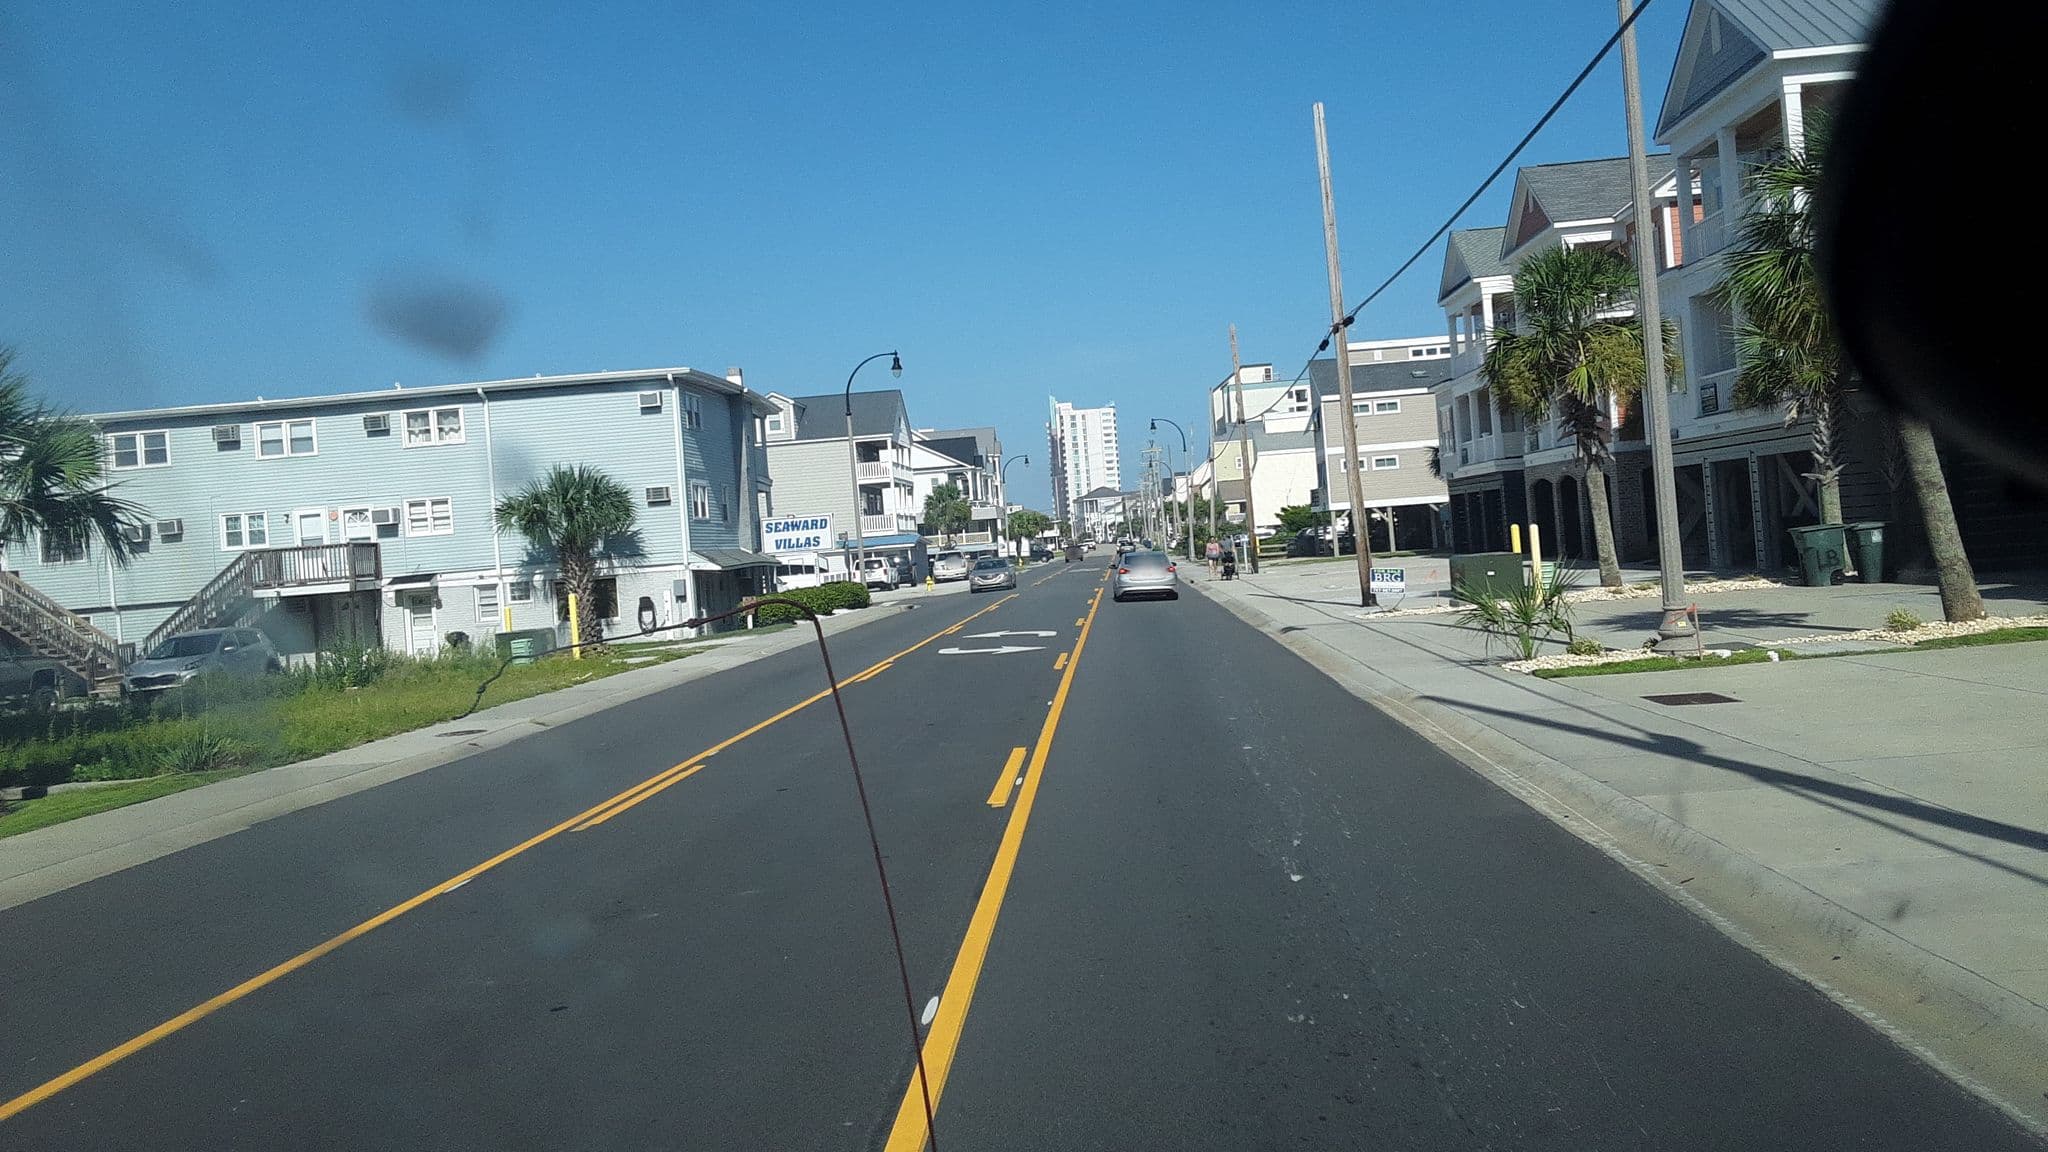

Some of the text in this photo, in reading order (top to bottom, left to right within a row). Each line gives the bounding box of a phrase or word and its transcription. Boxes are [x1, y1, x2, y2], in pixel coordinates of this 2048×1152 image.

[765, 518, 828, 534] SEAWARD
[774, 536, 821, 550] VILLAS
[1374, 573, 1401, 582] BRG
